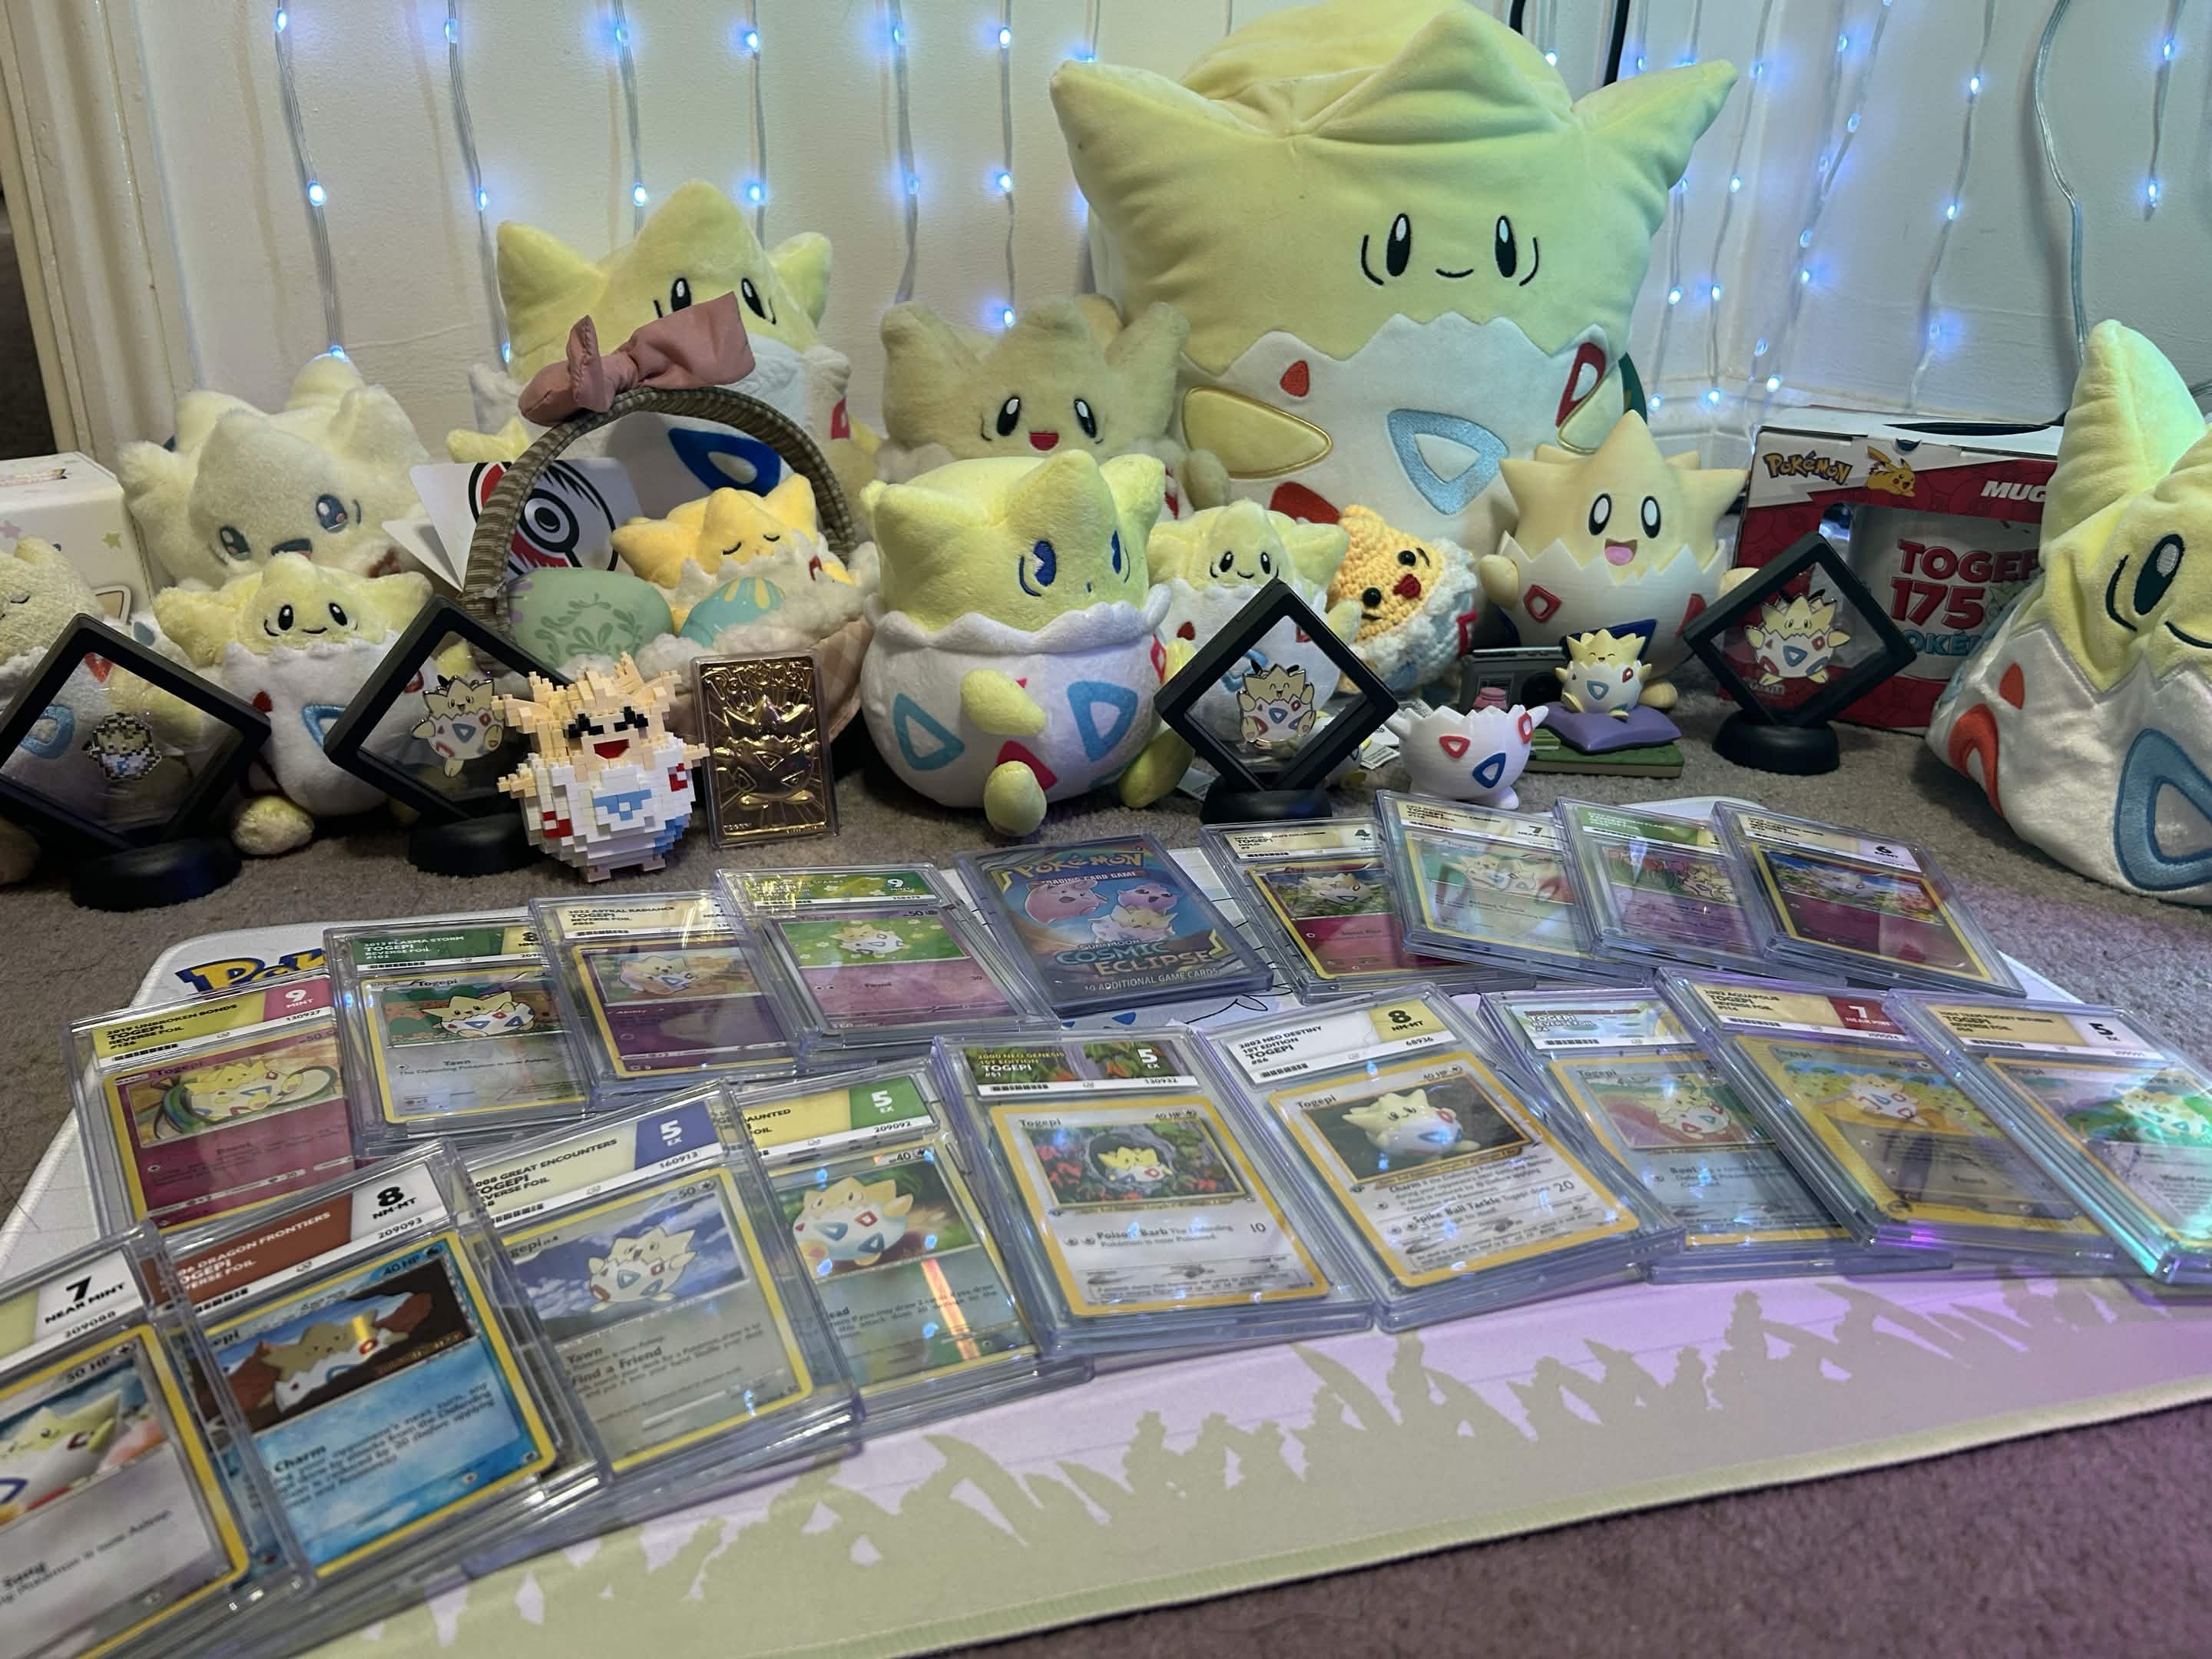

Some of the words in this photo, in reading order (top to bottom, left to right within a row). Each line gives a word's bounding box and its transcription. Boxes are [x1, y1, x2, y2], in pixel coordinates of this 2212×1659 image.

[1890, 577, 1985, 629] 175
[1528, 825, 1543, 834] 7
[1876, 846, 1892, 855] 6
[1111, 871, 1137, 879] GAME
[887, 879, 904, 887] 9
[1057, 942, 1169, 964] COSMIC
[1093, 950, 1214, 976] ECLIPSE
[418, 979, 458, 987] Togepi
[1098, 977, 1158, 991] ADDITIONAL
[1159, 972, 1185, 983] GAME
[1187, 969, 1218, 979] CARDS
[285, 989, 307, 1002] 9
[286, 998, 313, 1008] MINT
[1710, 995, 1753, 1004] TOGEPI
[106, 1025, 132, 1035] 2019
[133, 1012, 197, 1029] UNBROKEN
[199, 1005, 237, 1016] BONDS
[1388, 1010, 1412, 1024] 8
[1943, 1015, 1992, 1025] TOGEPI
[107, 1025, 164, 1040] TOGEPI
[1283, 1025, 1322, 1039] DESTINY
[1391, 1020, 1424, 1031] NM-MT
[2089, 1022, 2114, 1036] 5
[1242, 1045, 1260, 1054] 1ST
[1260, 1036, 1300, 1050] EDITION
[1137, 1048, 1158, 1064] 5
[1245, 1045, 1294, 1061] TOGEPI
[981, 1064, 1032, 1073] TOGEPI
[1578, 1068, 1617, 1077] Togepi
[870, 1090, 893, 1108] 5
[1296, 1094, 1337, 1110] Togepi
[879, 1105, 894, 1114] EX
[660, 1120, 682, 1141] 5
[874, 1121, 912, 1132] 209092
[1018, 1118, 1062, 1128] Togepi
[667, 1136, 683, 1147] EX
[475, 1177, 498, 1187] 008
[500, 1166, 537, 1181] GREAT
[539, 1138, 618, 1168] ENCOUNTERS
[896, 1152, 912, 1161] 40
[529, 1177, 551, 1189] FOIL
[1552, 1181, 1575, 1193] 20
[376, 1185, 406, 1207] 8
[372, 1197, 417, 1221] NM-MT
[1412, 1209, 1444, 1224] Spike
[1467, 1197, 1500, 1210] Tackle
[378, 1216, 424, 1240] 209093
[1096, 1229, 1139, 1241] Poiso
[1141, 1226, 1168, 1237] Barb
[1250, 1222, 1267, 1234] 10
[197, 1239, 258, 1270] DRAGON
[259, 1210, 330, 1247] FRONTIERS
[382, 1263, 401, 1277] 40
[65, 1276, 91, 1302] 7
[45, 1302, 86, 1324] NEAR
[88, 1282, 126, 1306] MINT
[566, 1347, 602, 1364] Yawn
[619, 1346, 663, 1369] Friend
[89, 1356, 112, 1371] HP
[273, 1445, 326, 1473] Charm
